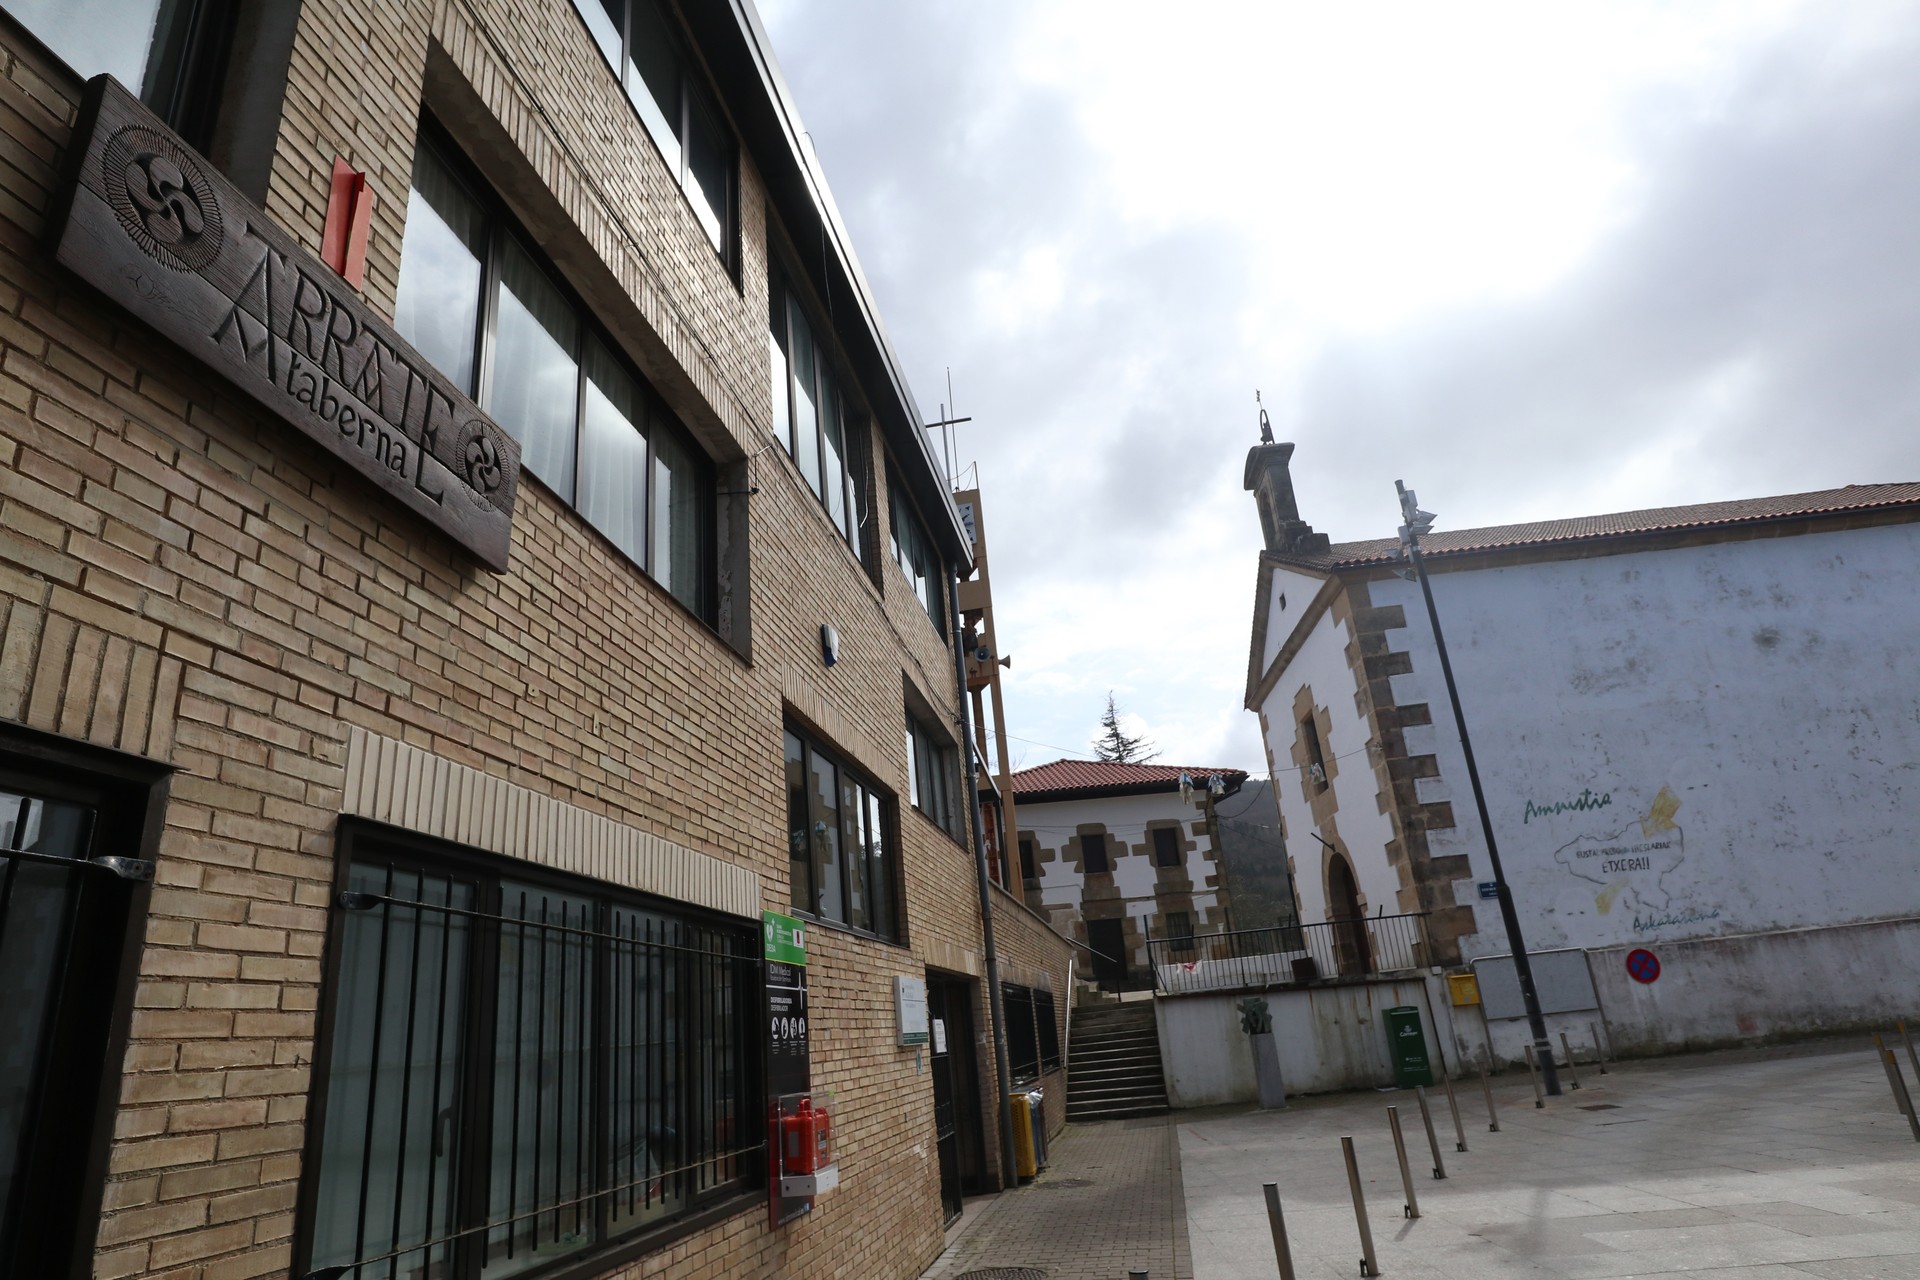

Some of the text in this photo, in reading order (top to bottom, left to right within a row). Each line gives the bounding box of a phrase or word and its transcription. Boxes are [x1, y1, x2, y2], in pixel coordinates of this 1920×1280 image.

[208, 220, 456, 507] ARRATE
[285, 352, 408, 481] taberna
[1602, 857, 1650, 874] ETXERA!!
